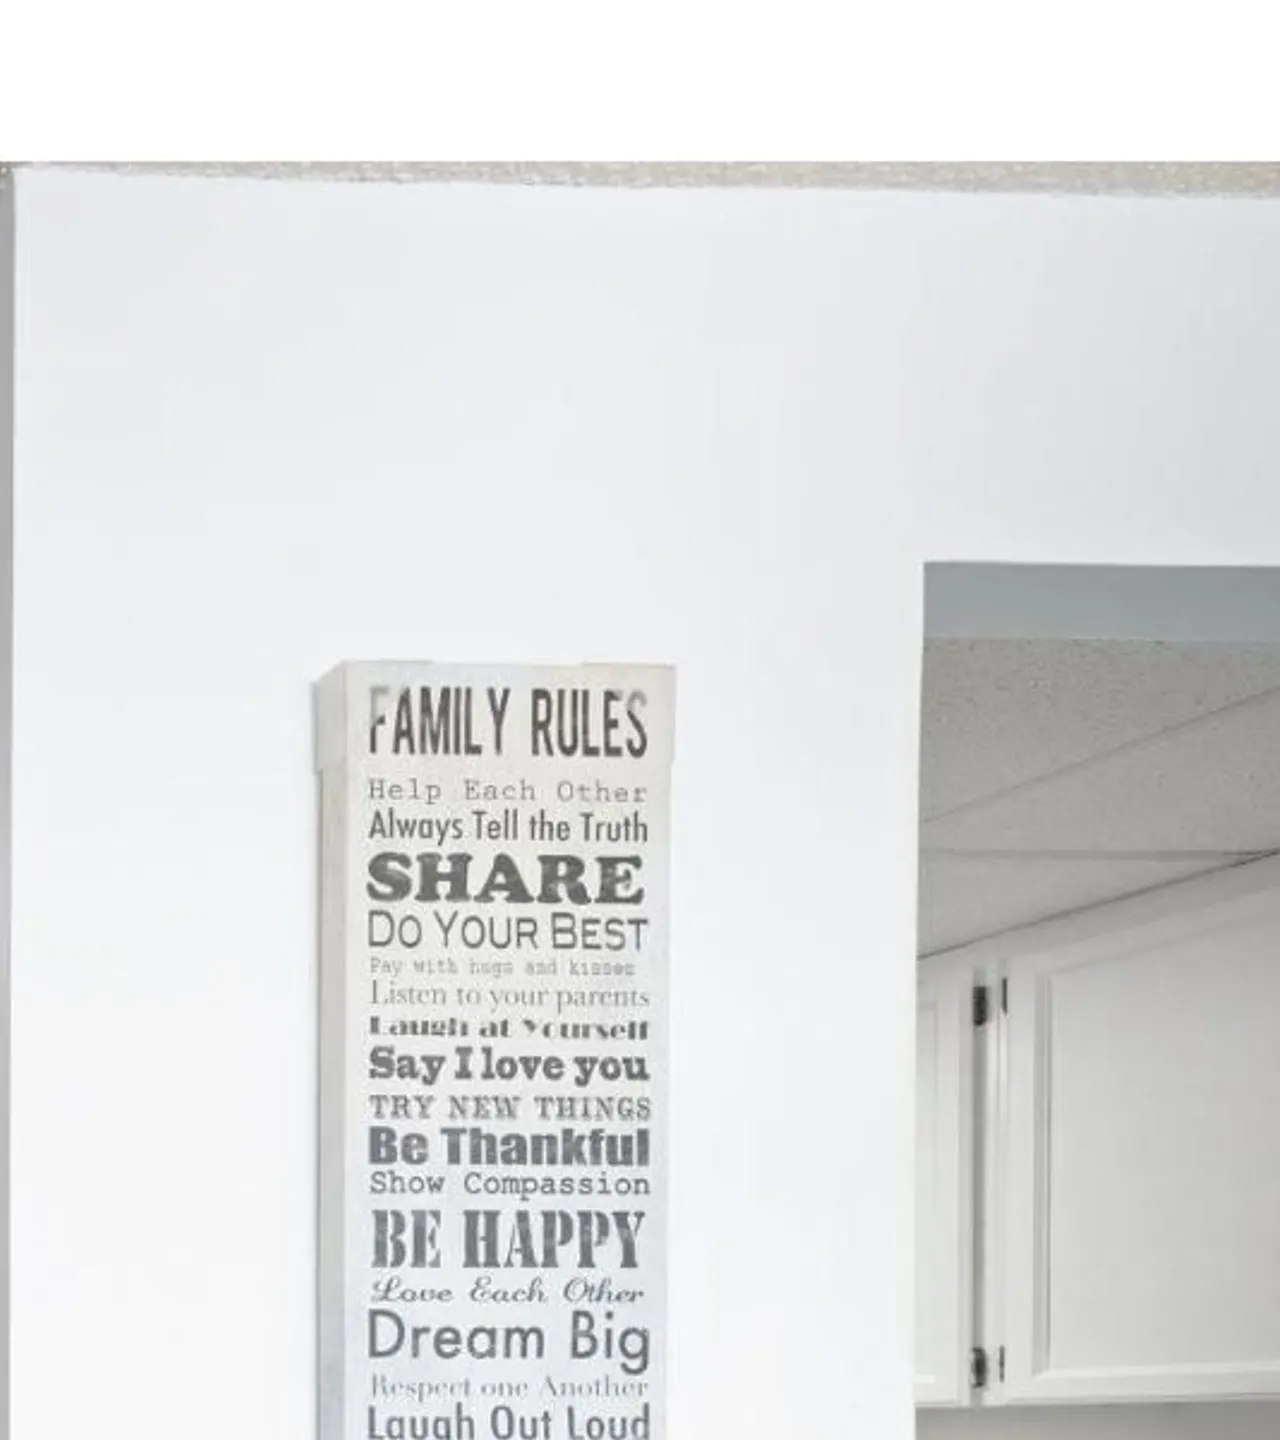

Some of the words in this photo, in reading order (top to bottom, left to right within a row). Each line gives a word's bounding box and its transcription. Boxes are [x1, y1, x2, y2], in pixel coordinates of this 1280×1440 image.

[368, 685, 511, 755] FAMILY
[531, 687, 648, 758] RULES
[368, 777, 441, 805] Help
[464, 778, 535, 801] Each
[557, 779, 647, 803] Other
[368, 807, 463, 846] Always
[471, 809, 518, 841] Tell
[529, 811, 571, 842] the
[579, 811, 648, 843] Truth
[366, 851, 645, 905] SHARE
[412, 957, 458, 974] with
[524, 959, 558, 976] and
[371, 979, 447, 1005] Listen
[456, 987, 481, 1005] to
[489, 988, 550, 1014] your
[556, 989, 650, 1014] parents
[478, 1018, 509, 1038] at
[368, 1045, 447, 1086] Say
[454, 1045, 473, 1081] I
[481, 1046, 565, 1081] love
[573, 1055, 651, 1087] you
[368, 1094, 436, 1120] TRY
[448, 1095, 522, 1120] NEW
[534, 1096, 651, 1121] THINGS
[368, 1125, 429, 1166] Be
[440, 1127, 650, 1167] Thankful
[369, 1170, 446, 1195] Show
[464, 1171, 651, 1202] Compassion
[370, 1208, 441, 1269] BE
[462, 1209, 646, 1269] HAPPY
[371, 1275, 453, 1303] Love
[468, 1276, 547, 1304] Each
[563, 1276, 645, 1304] Other
[368, 1308, 544, 1360] Dream
[571, 1309, 650, 1376] Big
[371, 1373, 471, 1402] Respect
[480, 1382, 528, 1398] one
[541, 1373, 649, 1398] Another
[490, 1405, 551, 1440] Out
